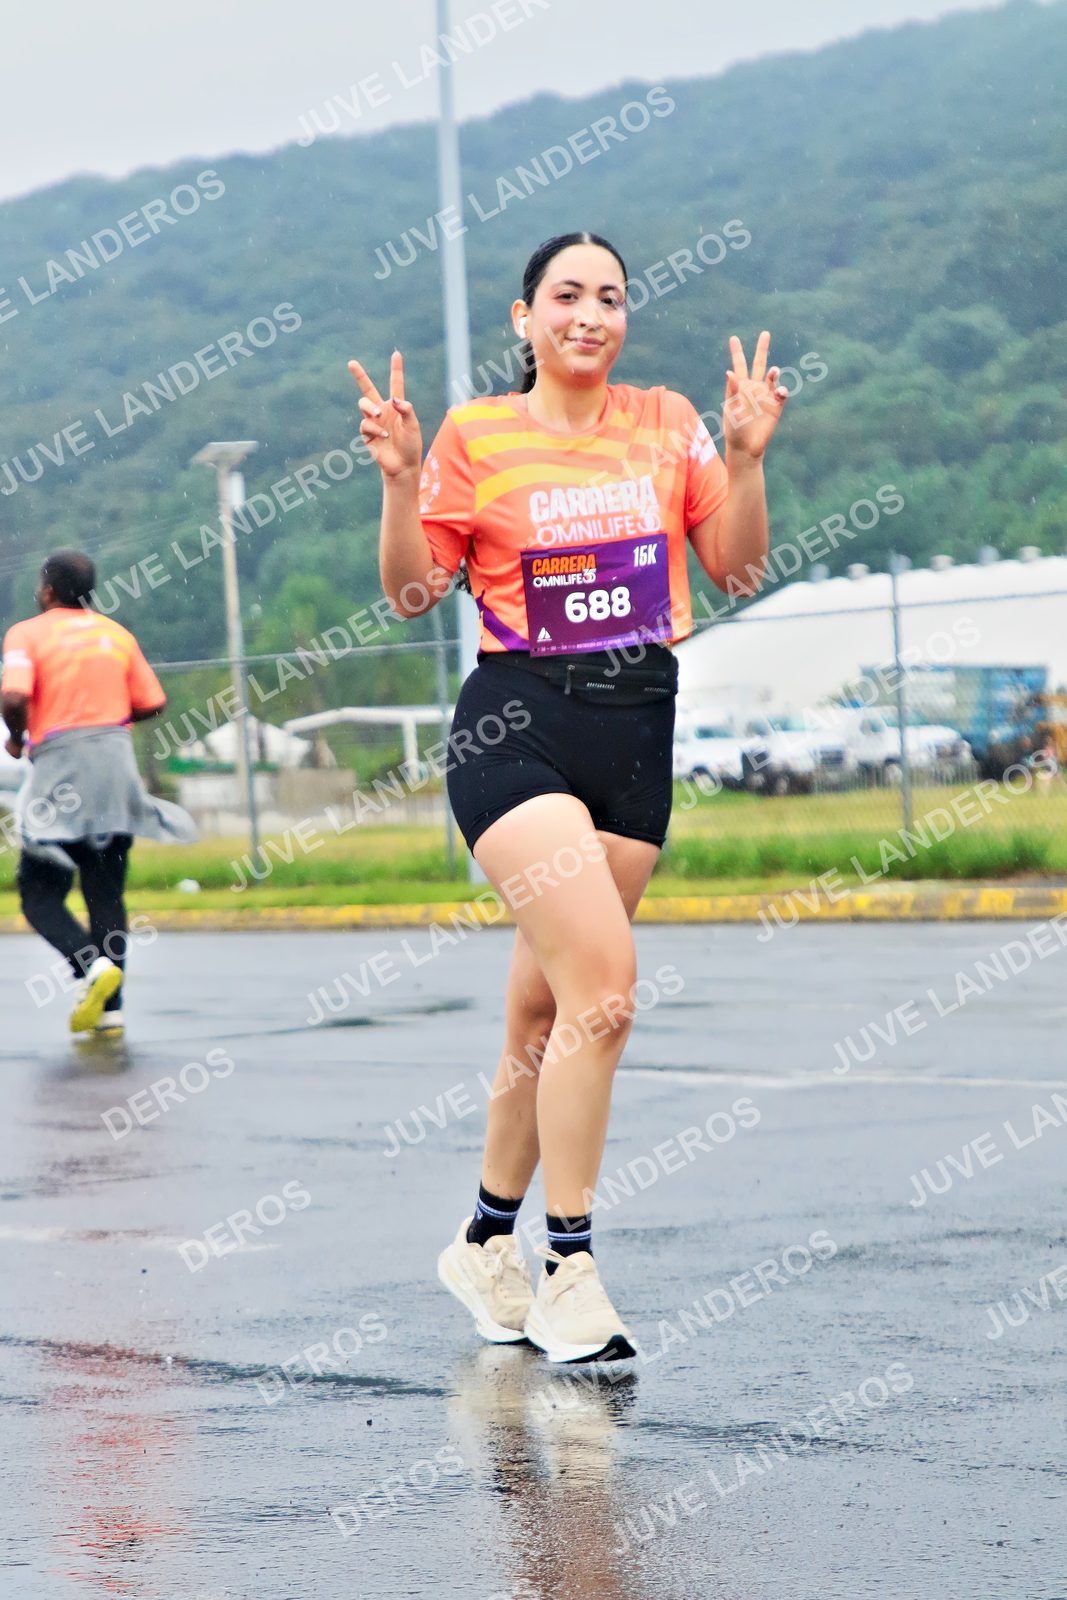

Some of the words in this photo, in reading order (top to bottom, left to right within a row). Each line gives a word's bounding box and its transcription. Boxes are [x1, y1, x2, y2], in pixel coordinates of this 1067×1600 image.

[529, 475, 658, 522] CARRERA
[536, 514, 637, 546] OMNILIFE
[532, 553, 597, 575] CARRERA
[633, 543, 658, 567] 15K
[533, 573, 583, 588] OMNILIFE
[564, 587, 631, 623] 688
